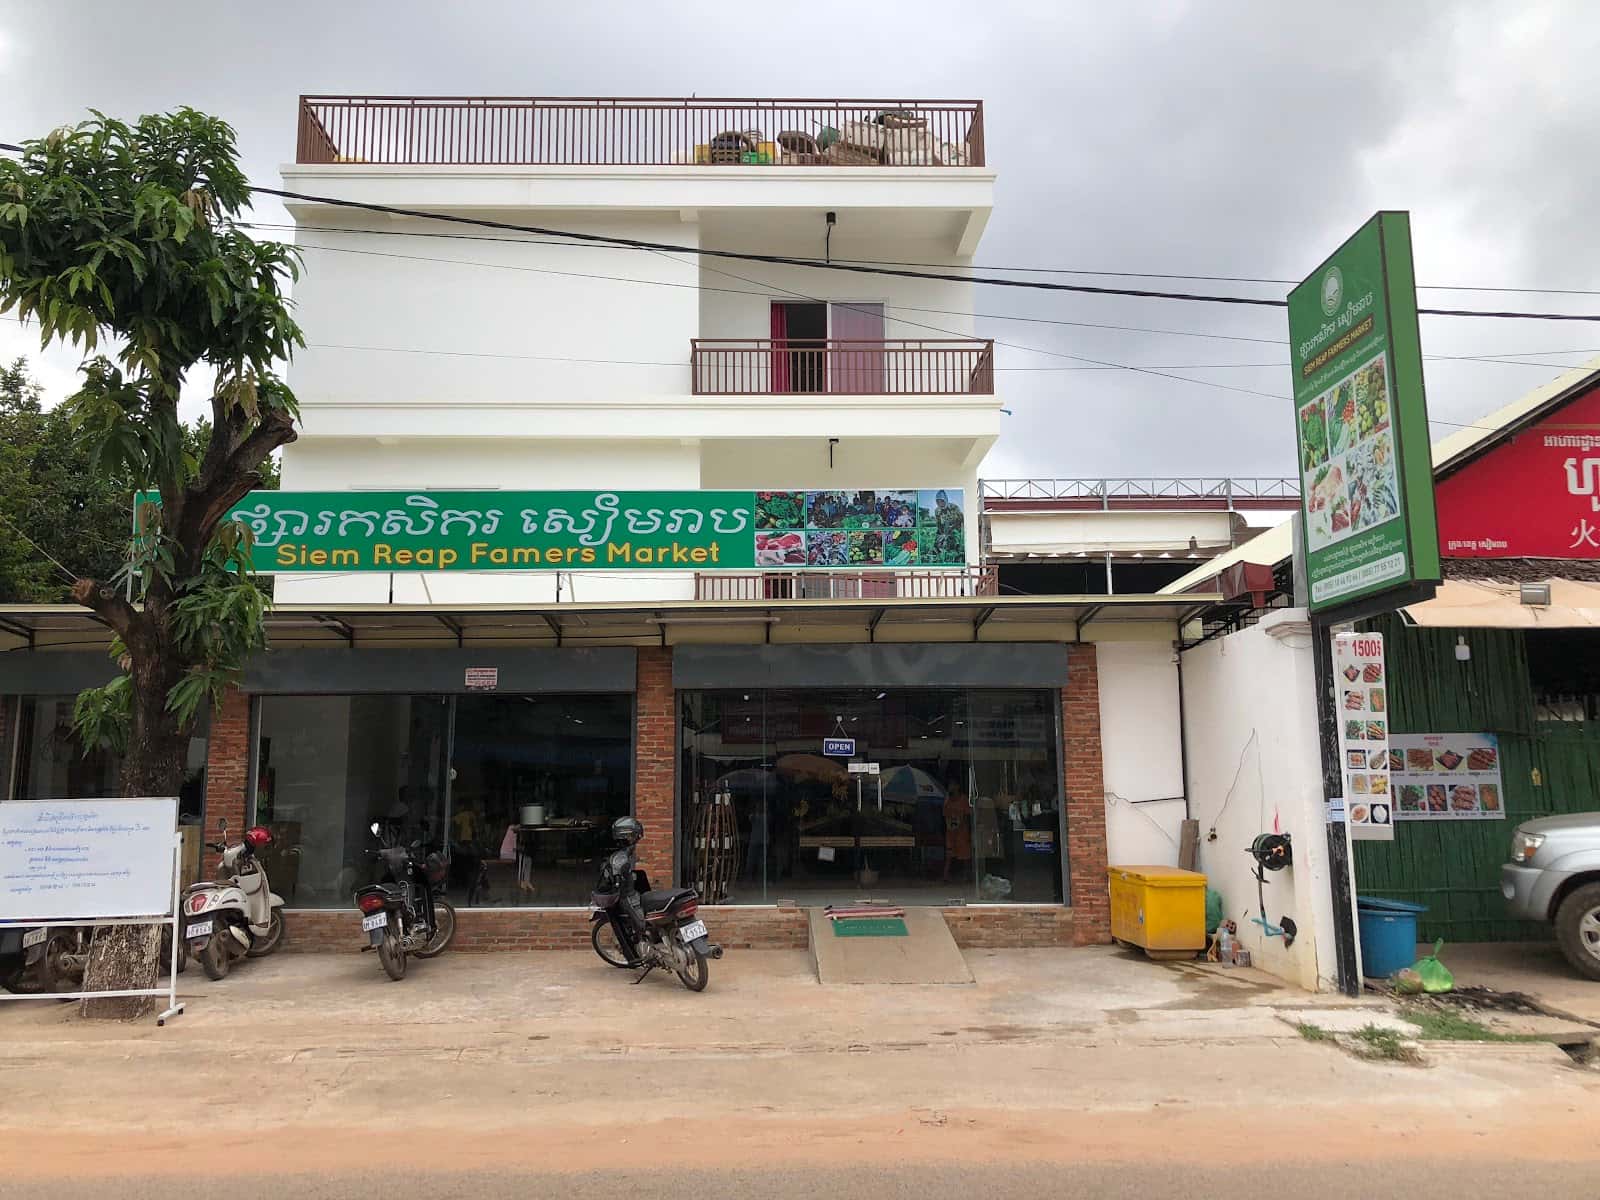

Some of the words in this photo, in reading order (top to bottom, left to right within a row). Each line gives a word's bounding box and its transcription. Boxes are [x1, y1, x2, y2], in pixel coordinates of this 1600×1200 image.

[1350, 317, 1372, 341] MARKET
[520, 493, 749, 546] សៀមរាប
[277, 543, 359, 565] Siem
[374, 543, 457, 570] Reap
[471, 543, 595, 565] Famers
[608, 542, 719, 564] Market
[828, 743, 851, 751] OPEN
